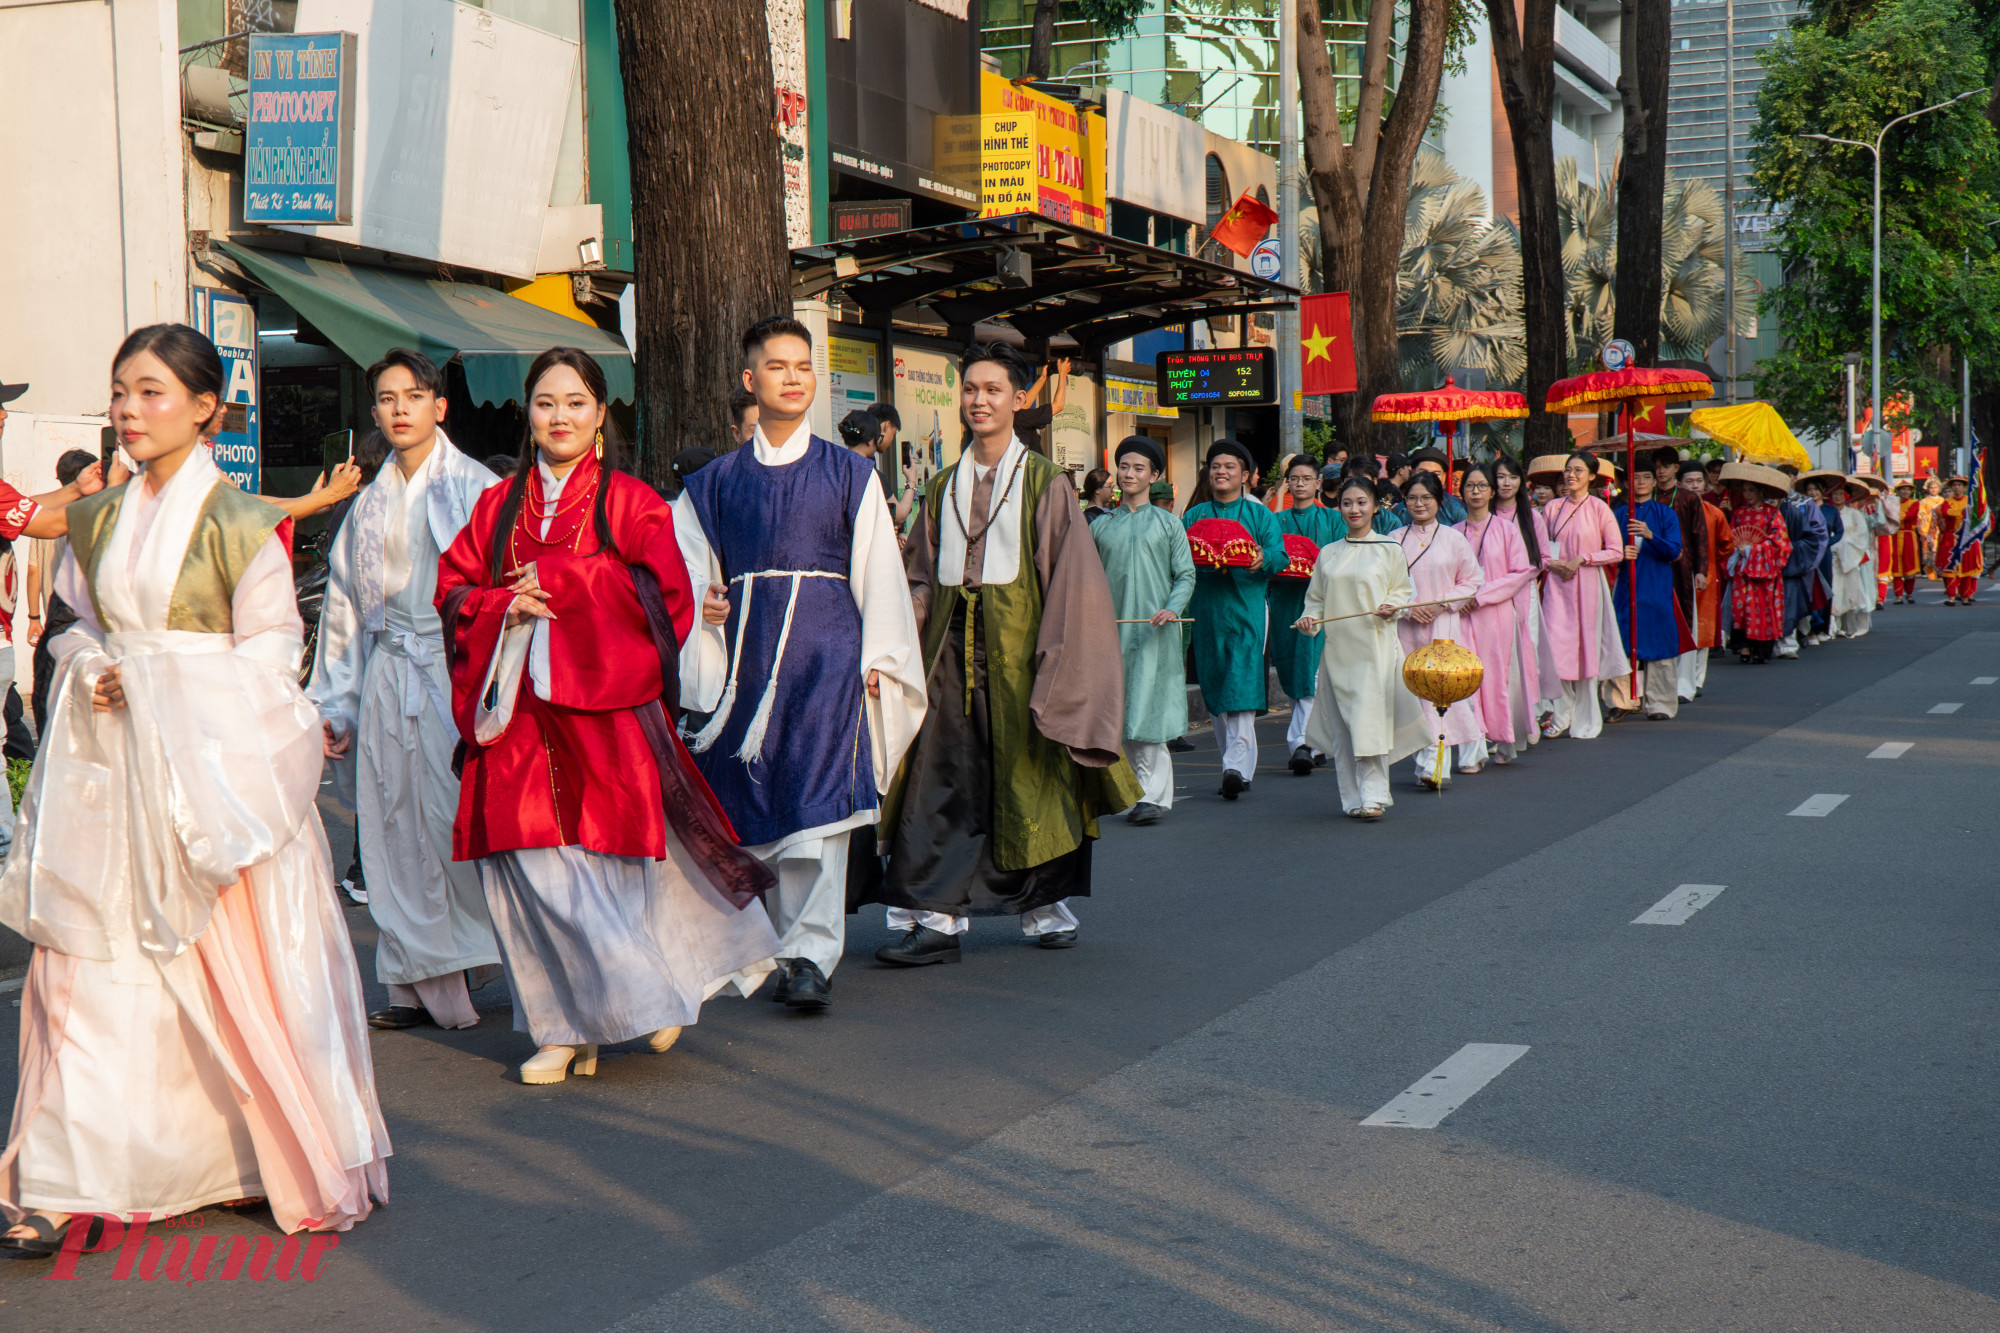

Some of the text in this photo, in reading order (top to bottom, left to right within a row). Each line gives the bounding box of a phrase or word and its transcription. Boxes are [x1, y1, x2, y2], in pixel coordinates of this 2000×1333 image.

[254, 41, 337, 80] IN VI TÍNH
[252, 91, 336, 122] PHOTOCOPY
[995, 122, 1017, 134] CHỤP
[984, 136, 1008, 150] HÌNH
[1011, 133, 1029, 149] THẺ
[250, 127, 336, 185] VĂN PHÒNG PHẨM
[983, 161, 1031, 171] PHOTOCOPY
[1053, 145, 1084, 190] TÂN
[985, 179, 996, 188] IN
[250, 192, 269, 210] Thiết
[292, 192, 312, 210] Đánh
[314, 192, 333, 214] Máy
[984, 194, 994, 203] IN
[840, 212, 899, 230] QUÁN CƠM
[217, 346, 253, 360] Double A
[1213, 354, 1226, 362] TIN
[1200, 369, 1210, 377] 04
[1236, 367, 1252, 375] 152
[1170, 380, 1193, 389] PHÚT
[1176, 392, 1188, 400] XE
[215, 444, 256, 463] PHOTO
[223, 471, 253, 490] OPY
